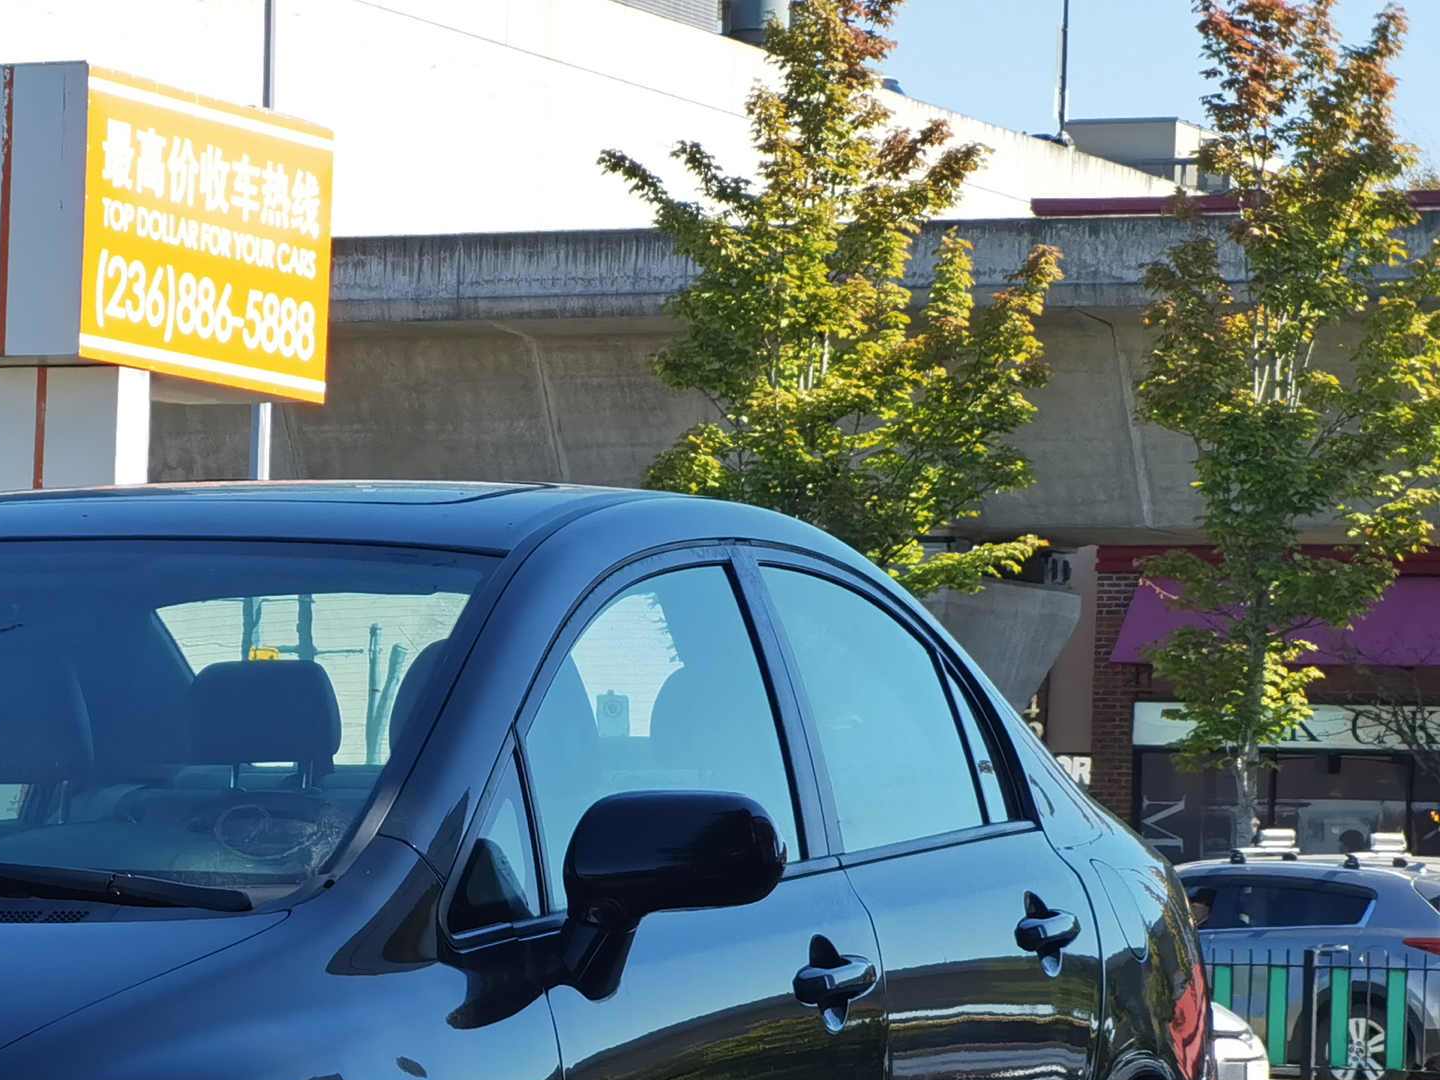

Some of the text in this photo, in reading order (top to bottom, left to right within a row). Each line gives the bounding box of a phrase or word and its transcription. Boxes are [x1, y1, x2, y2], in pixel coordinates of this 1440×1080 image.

[102, 117, 321, 239] 最高价收车热线
[102, 197, 317, 280] TOP DOLLAR FOR YOUR CARS
[96, 248, 316, 361] (236)886-5888
